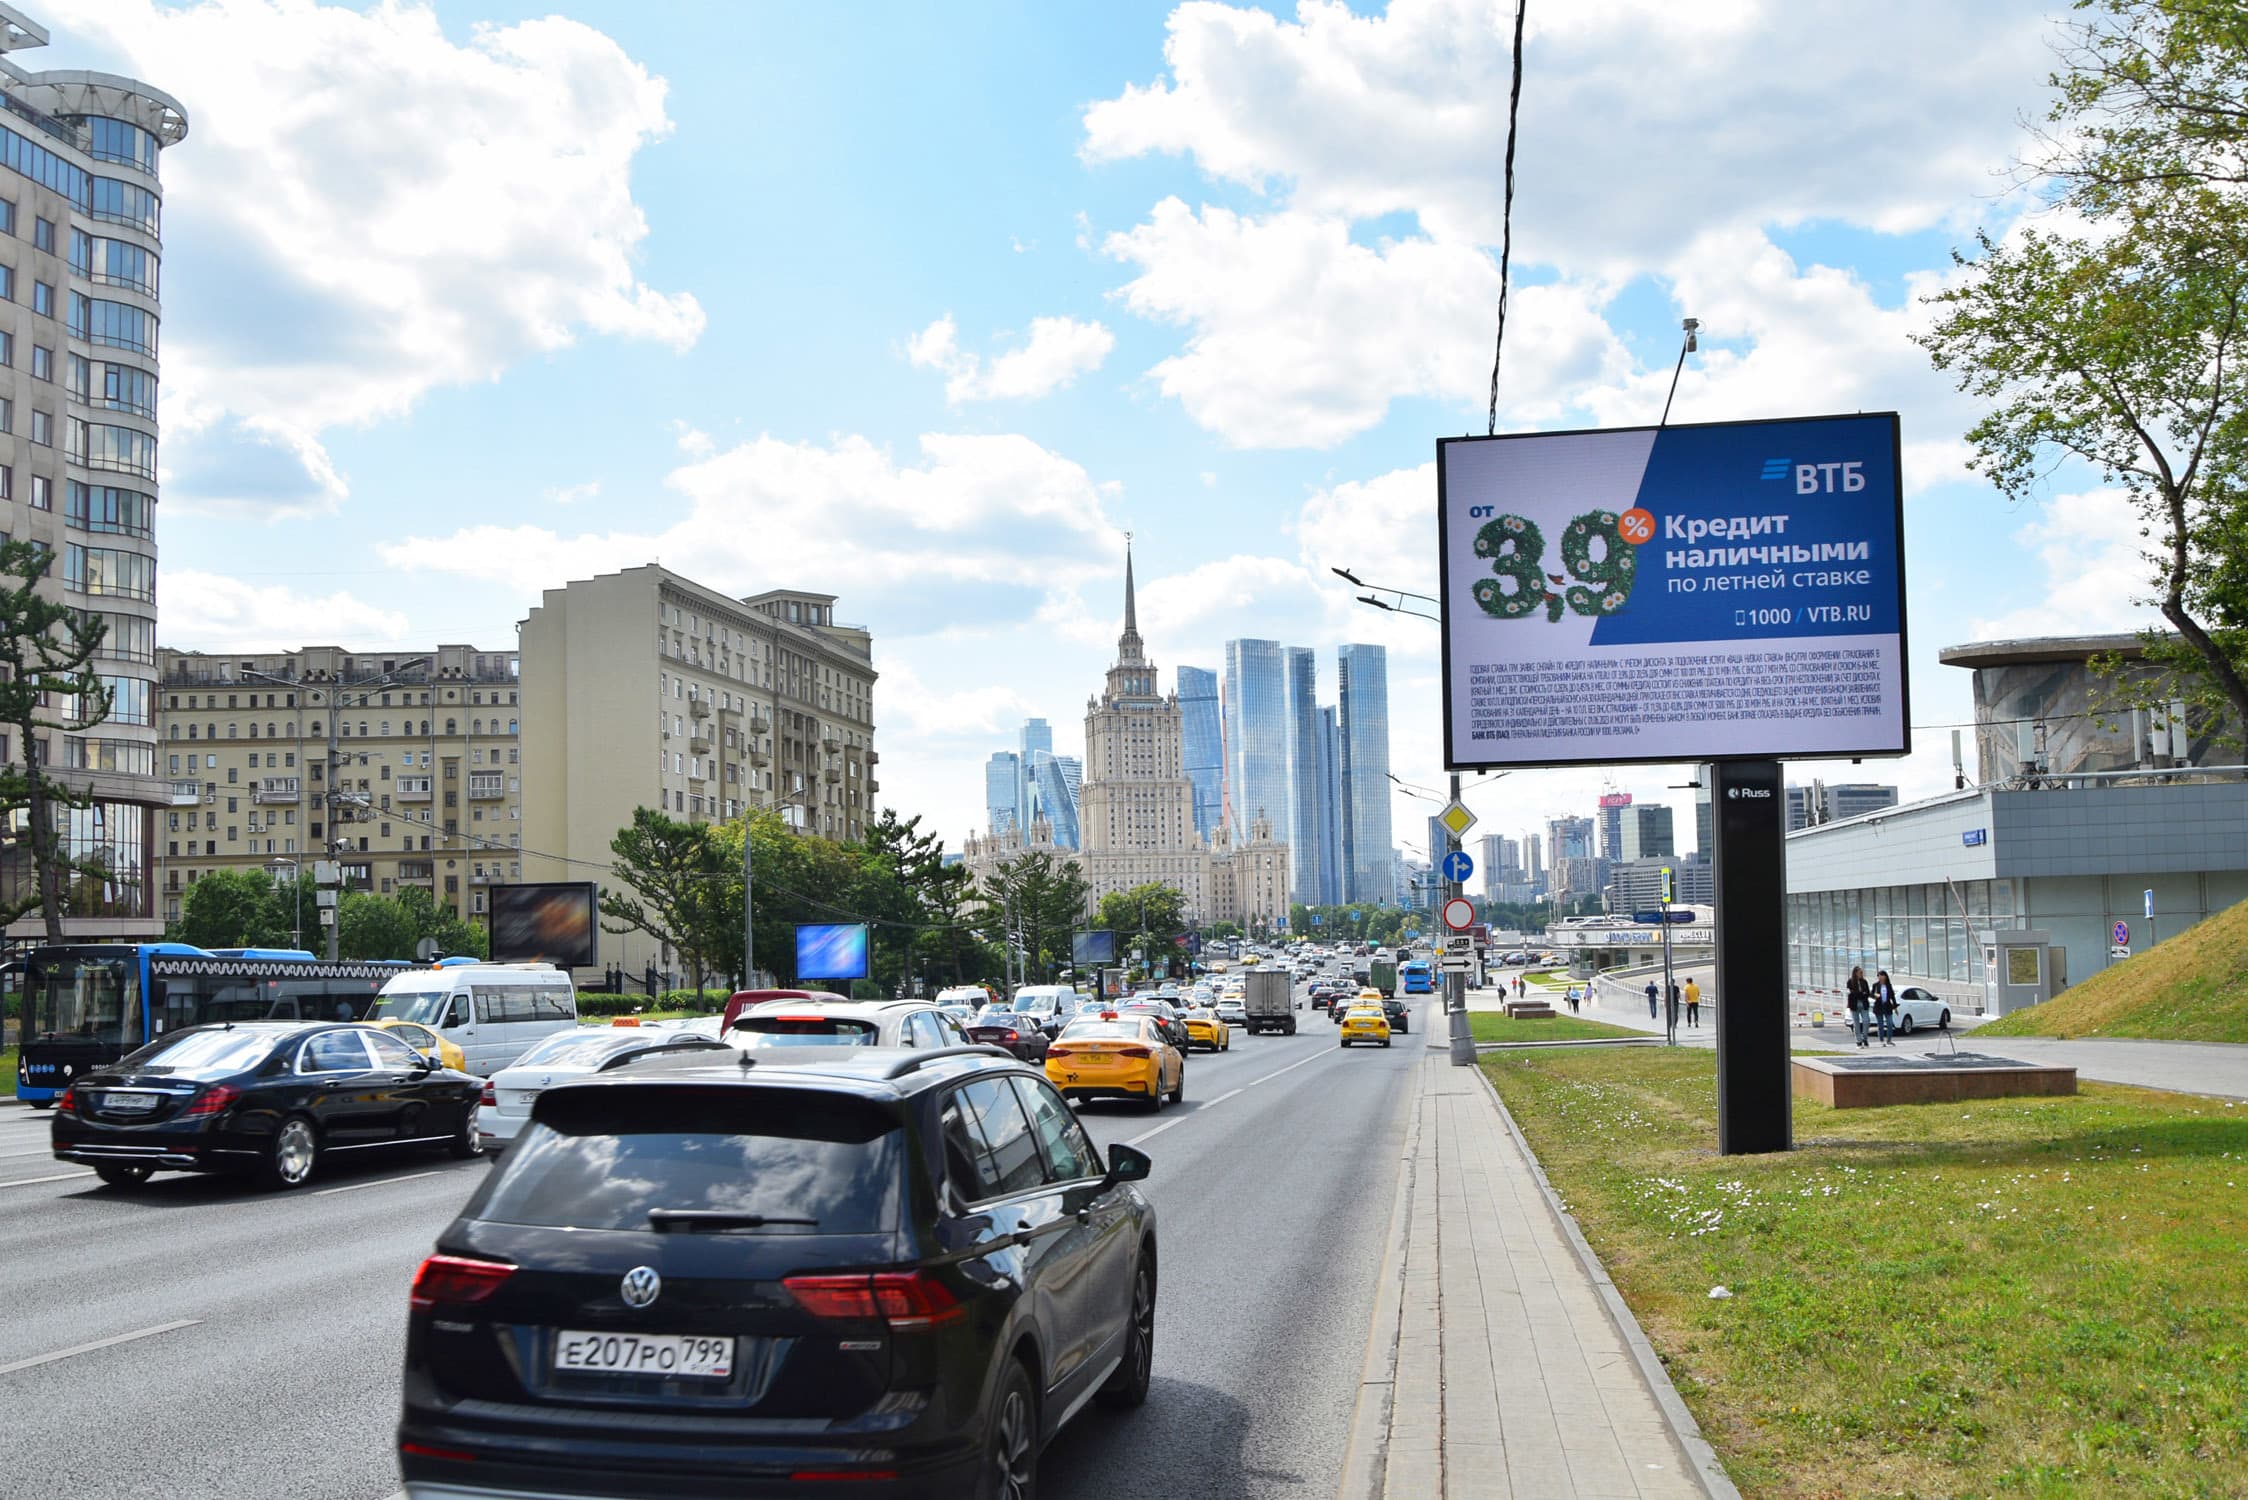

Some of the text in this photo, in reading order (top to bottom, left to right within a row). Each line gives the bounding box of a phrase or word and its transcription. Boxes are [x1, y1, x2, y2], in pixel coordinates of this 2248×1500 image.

[1795, 461, 1866, 495] ВТБ
[1665, 514, 1789, 544] Кредит
[1666, 541, 1869, 568] наличными
[1668, 569, 1870, 593] по летней ставке
[1748, 608, 1791, 625] 1000
[1807, 605, 1871, 623] VTB.RU
[1742, 788, 1770, 798] Russ
[682, 1339, 725, 1363] 799
